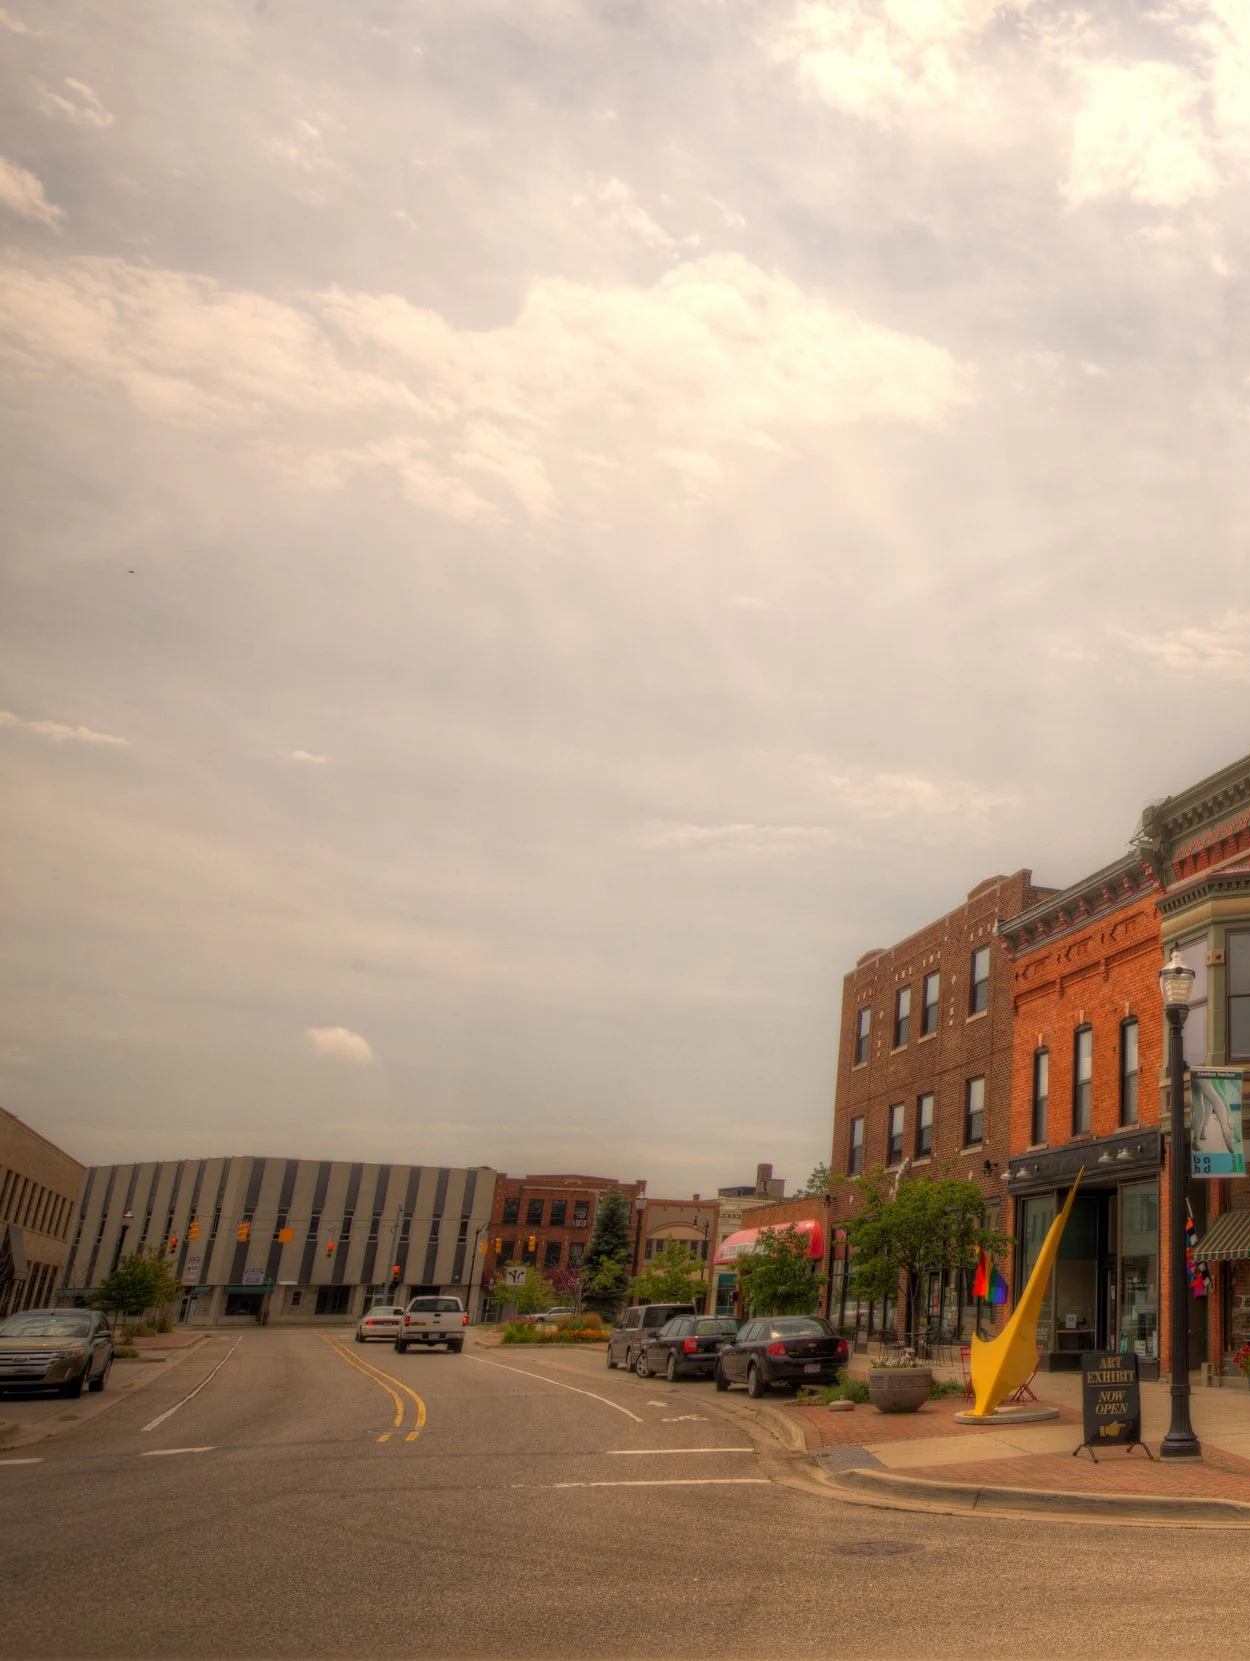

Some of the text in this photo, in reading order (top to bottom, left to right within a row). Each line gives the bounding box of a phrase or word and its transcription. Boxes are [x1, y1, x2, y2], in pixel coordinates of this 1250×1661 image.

[1099, 1356, 1122, 1369] ART
[1087, 1370, 1136, 1384] EXHIBIT
[1098, 1390, 1126, 1402] NOW
[1095, 1403, 1128, 1416] OPEN
